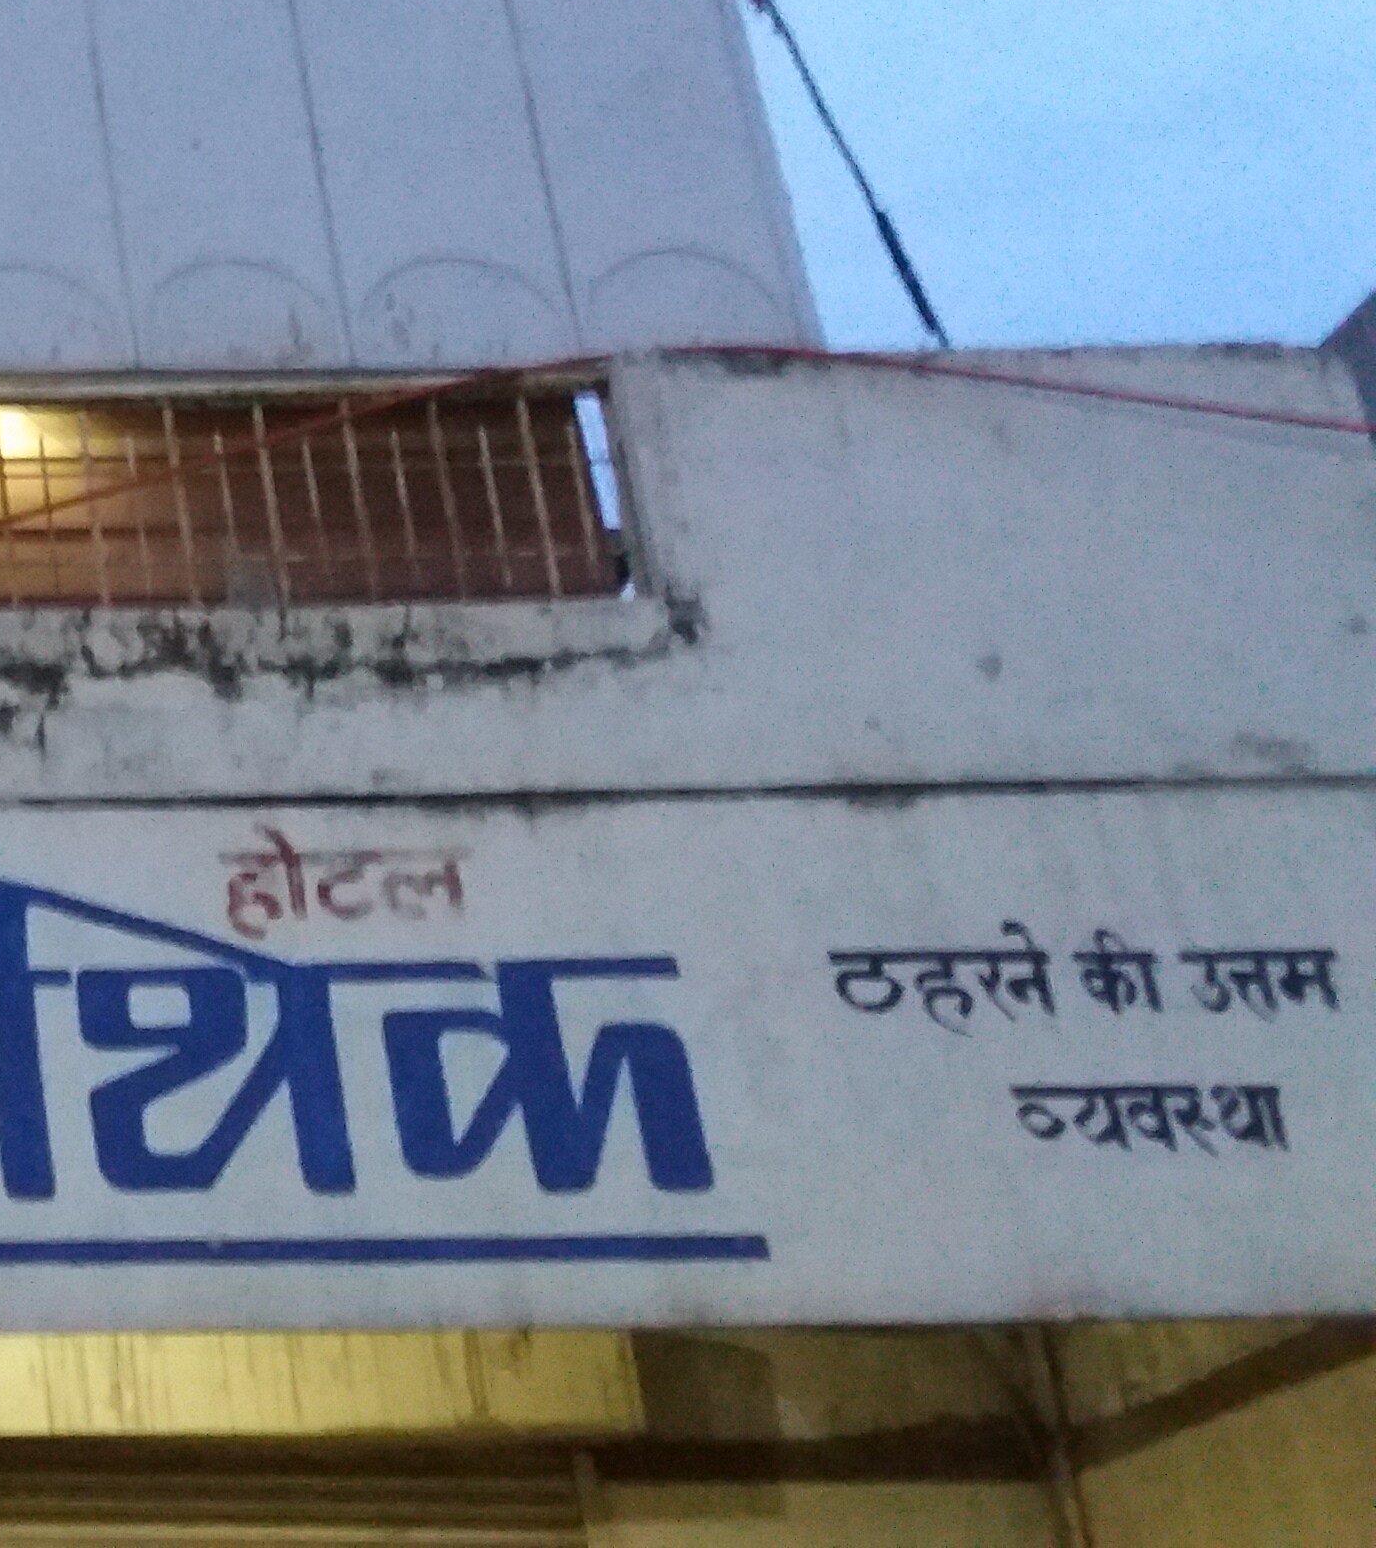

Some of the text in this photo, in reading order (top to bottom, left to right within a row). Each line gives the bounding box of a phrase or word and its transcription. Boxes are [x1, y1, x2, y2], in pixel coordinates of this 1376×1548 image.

[219, 824, 472, 939] होटल
[827, 918, 1057, 1038] ठहरने
[1072, 928, 1163, 1015] की
[1009, 1084, 1291, 1157] व्यवस्था
